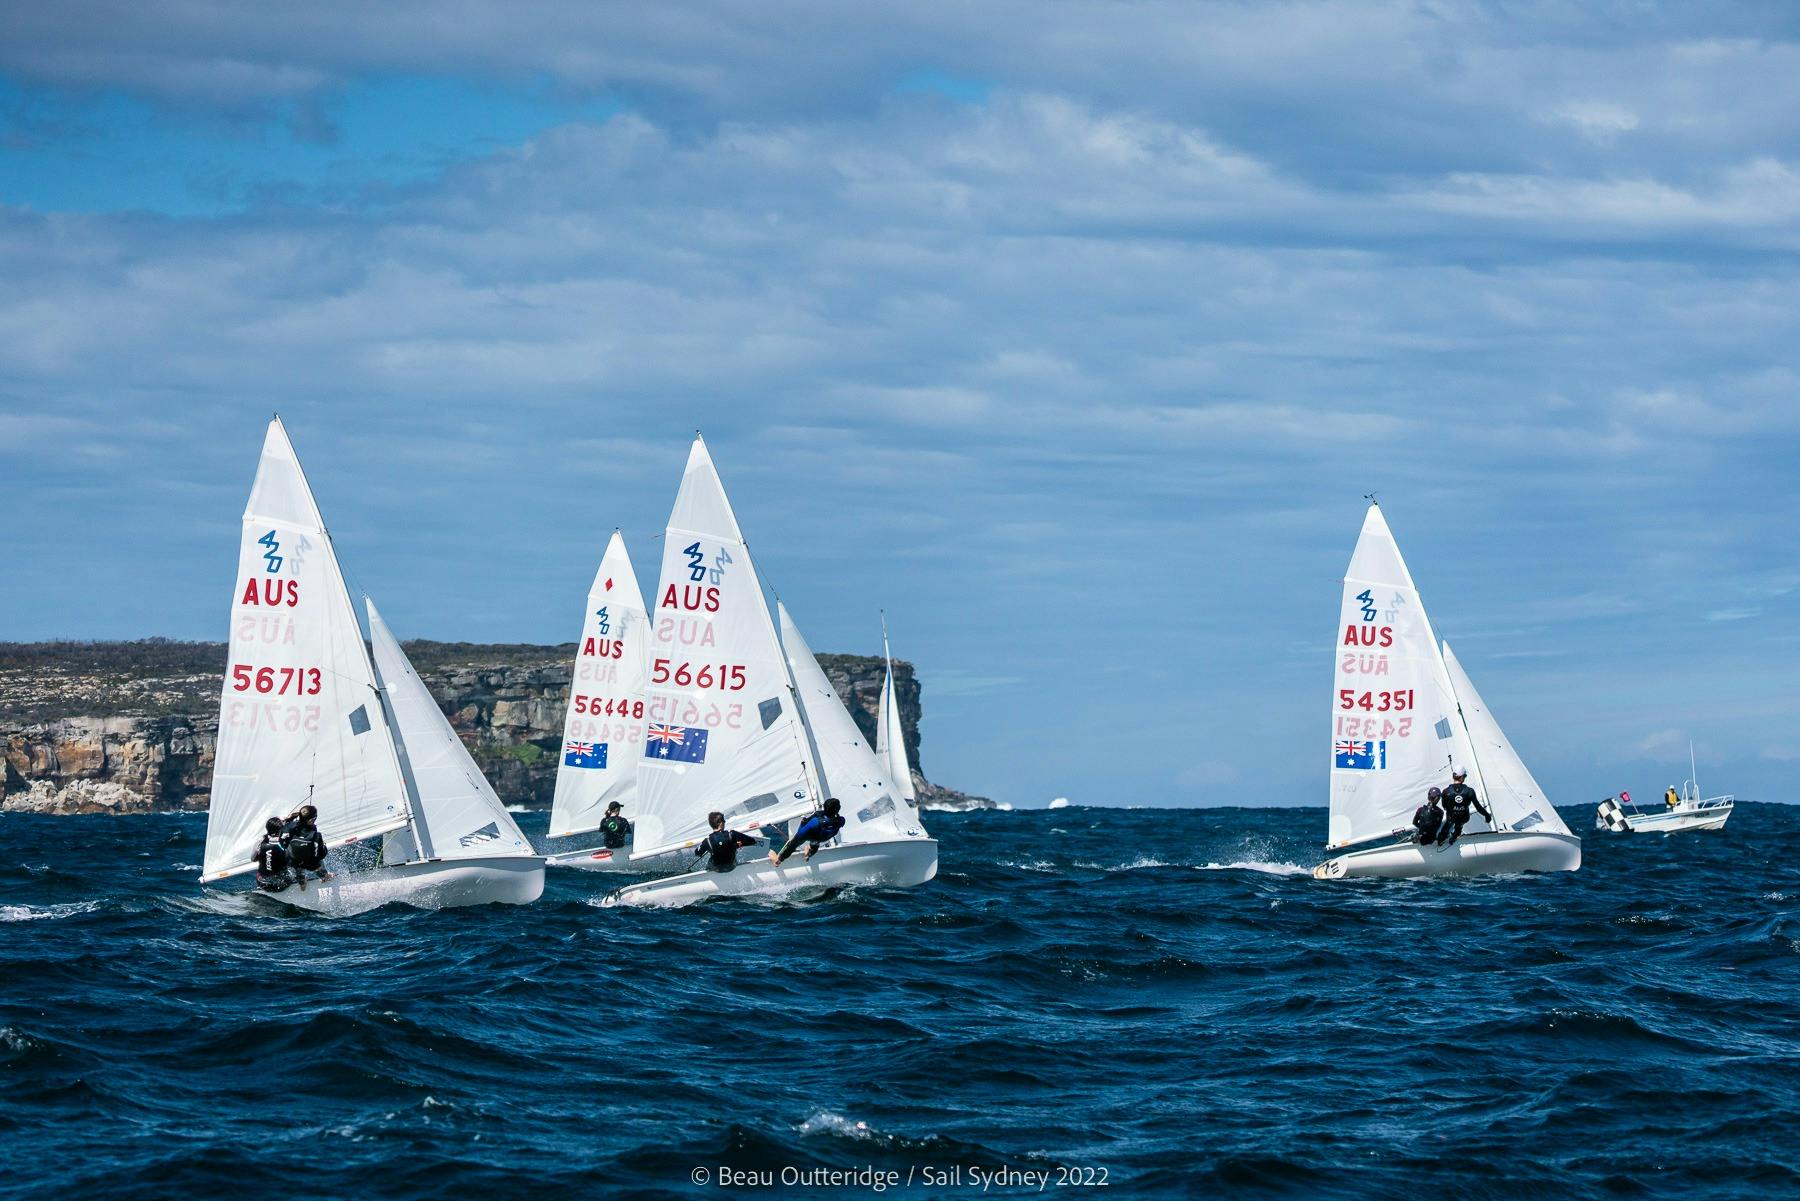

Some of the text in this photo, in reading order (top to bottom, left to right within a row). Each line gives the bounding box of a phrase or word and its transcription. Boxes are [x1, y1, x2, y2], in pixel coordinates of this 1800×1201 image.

[257, 529, 284, 573] 420
[682, 541, 707, 582] 420
[241, 577, 299, 608] AUS
[661, 583, 721, 613] AUS
[1356, 589, 1378, 622] 420
[596, 606, 610, 635] 420
[583, 637, 624, 660] AUS
[1343, 624, 1393, 648] AUS
[233, 664, 322, 696] 56713
[651, 658, 747, 691] 56615
[574, 694, 645, 720] 56448
[1339, 689, 1414, 712] 54351
